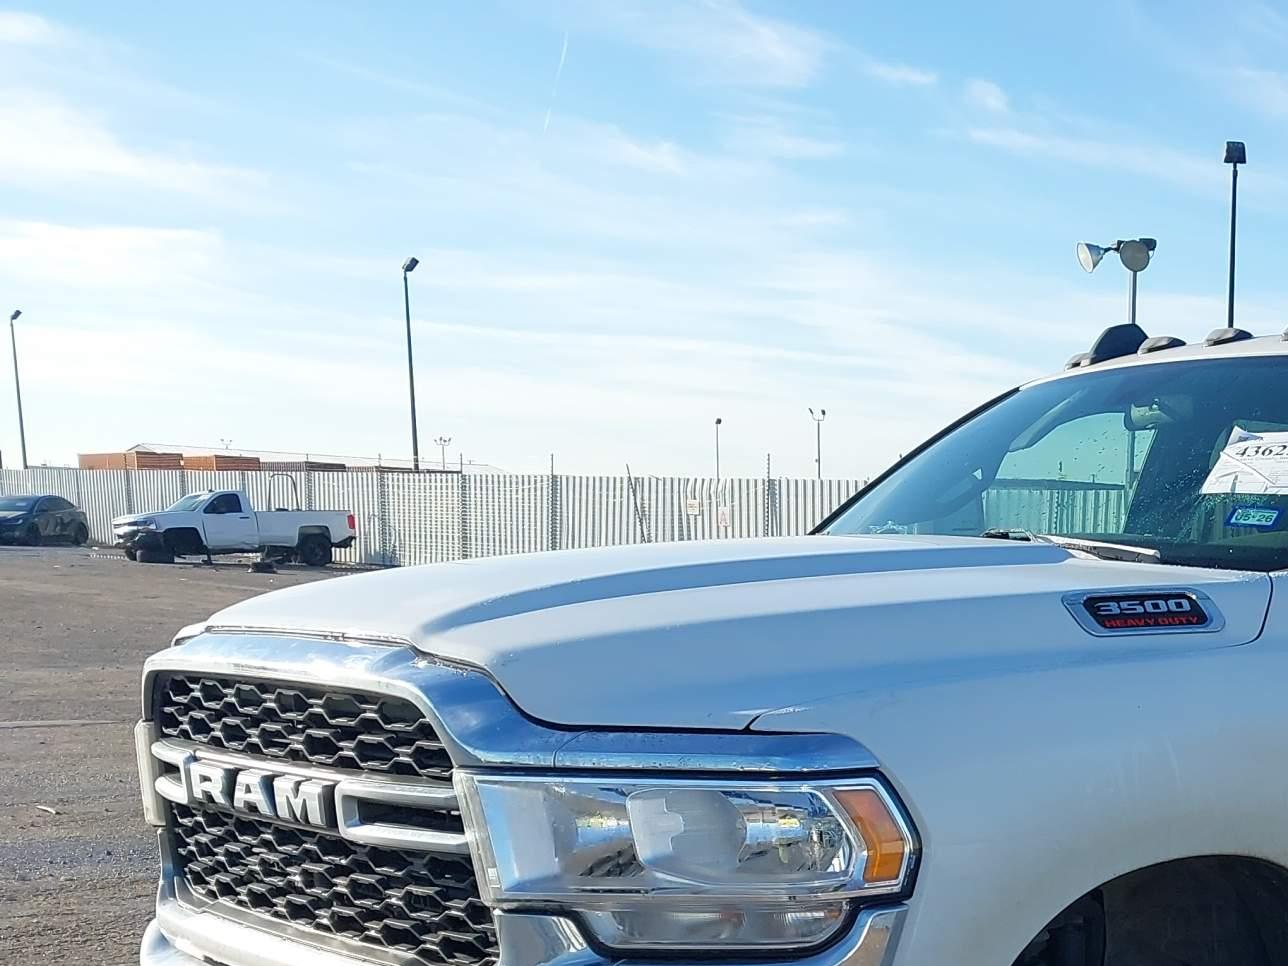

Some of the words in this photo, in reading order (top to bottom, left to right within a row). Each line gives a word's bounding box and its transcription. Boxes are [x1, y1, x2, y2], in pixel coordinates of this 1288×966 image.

[1094, 599, 1191, 615] 3500
[1104, 618, 1154, 628] HEAVY
[1158, 616, 1198, 625] DUTY
[189, 760, 334, 827] RAM
